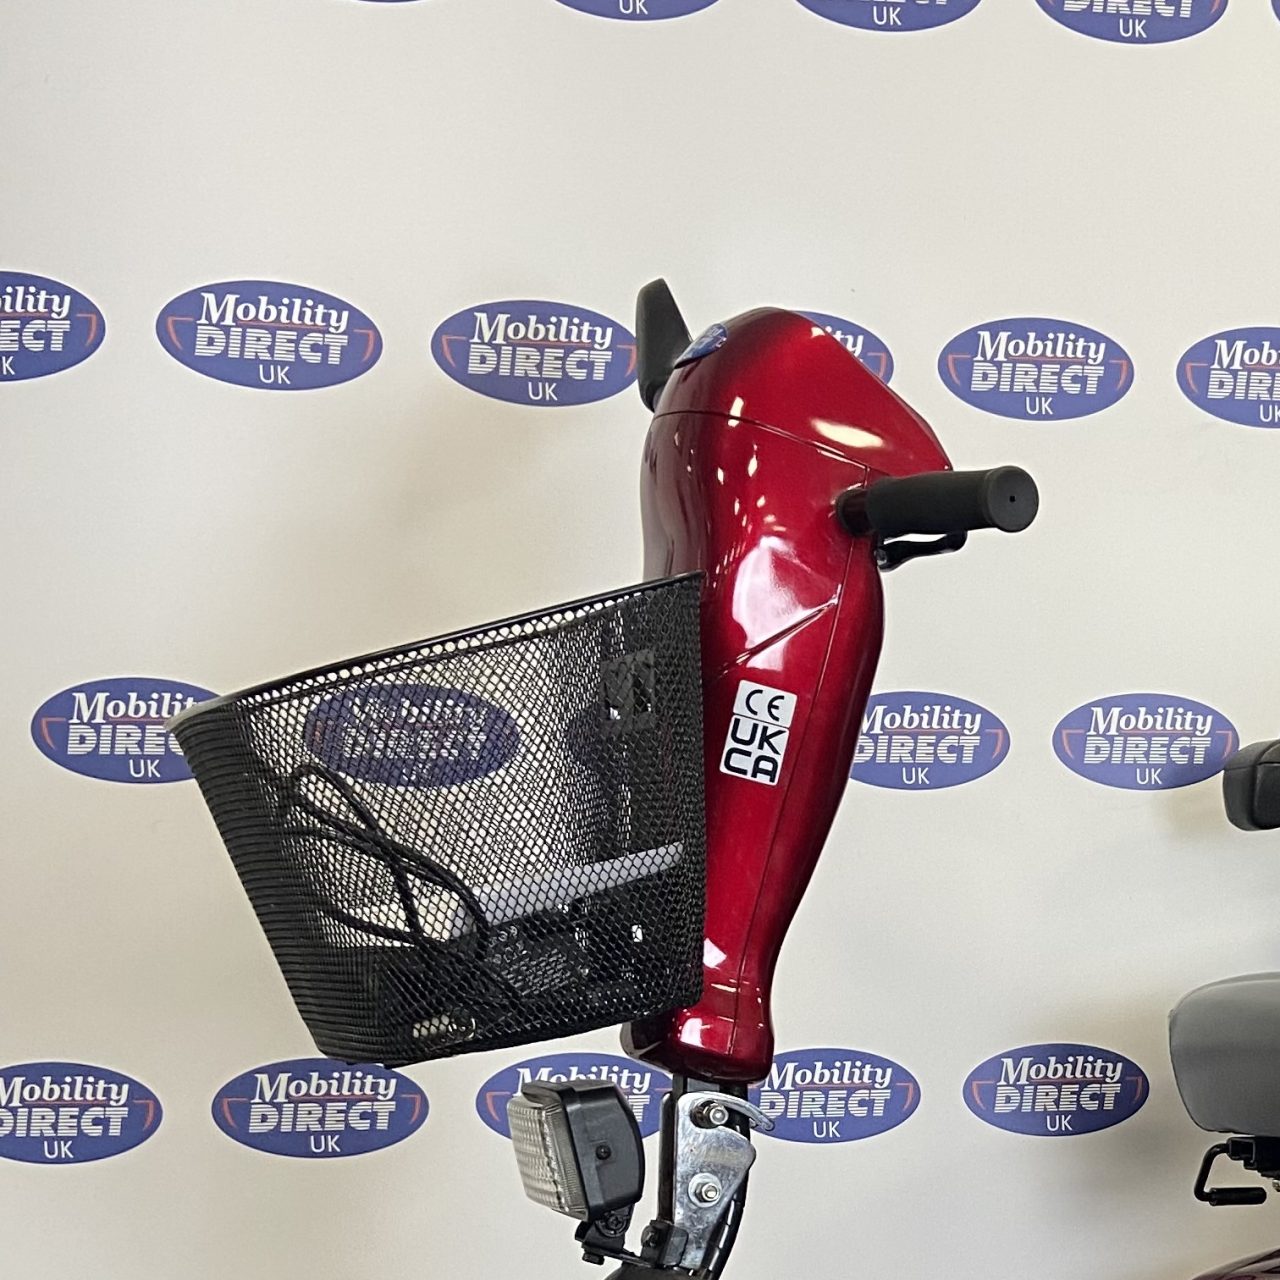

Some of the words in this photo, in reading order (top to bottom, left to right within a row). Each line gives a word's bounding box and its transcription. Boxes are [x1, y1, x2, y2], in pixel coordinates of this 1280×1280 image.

[872, 5, 902, 26] UK
[1119, 18, 1148, 39] UK
[0, 286, 71, 320] ility
[196, 291, 350, 334] Mobility
[469, 311, 614, 349] Mobility
[194, 325, 349, 366] DIRECT
[974, 330, 1107, 365] Mobility
[258, 364, 292, 385] UK
[467, 344, 612, 381] DIRECT
[527, 381, 559, 402] UK
[970, 361, 1105, 395] DIRECT
[1024, 395, 1055, 416] UK
[745, 689, 785, 721] CE
[861, 704, 982, 736] Mobility
[1089, 705, 1213, 738] Mobility
[853, 735, 981, 764] DIRECT
[1084, 735, 1211, 765] DIRECT
[129, 759, 161, 779] UK
[902, 767, 930, 785] UK
[1135, 767, 1163, 786] UK
[760, 1060, 893, 1091] Mobility
[1000, 1056, 1123, 1086] Mobility
[254, 1071, 398, 1104] Mobility
[994, 1083, 1122, 1113] DIRECT
[248, 1101, 397, 1134] DIRECT
[759, 1089, 892, 1119] DIRECT
[812, 1120, 841, 1138] UK
[1046, 1114, 1074, 1132] UK
[43, 1140, 75, 1159] UK
[309, 1134, 341, 1154] UK
